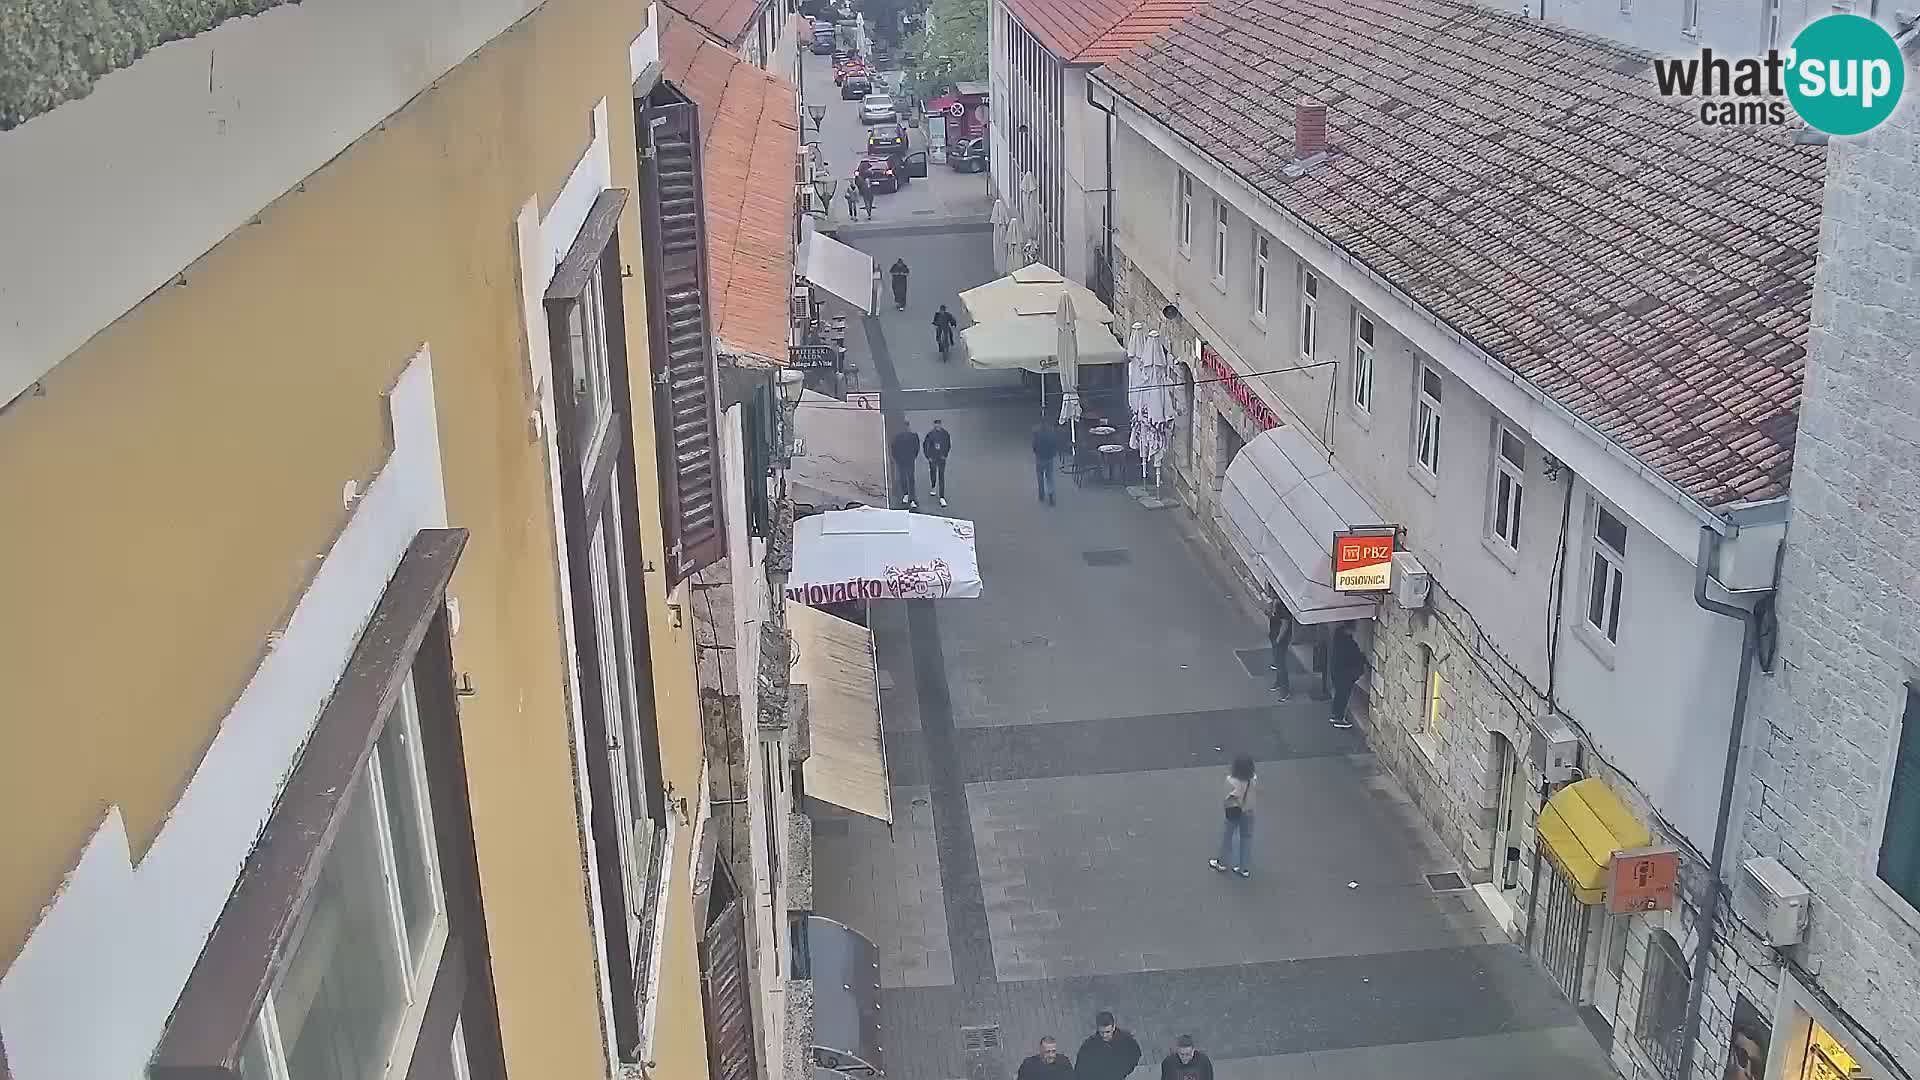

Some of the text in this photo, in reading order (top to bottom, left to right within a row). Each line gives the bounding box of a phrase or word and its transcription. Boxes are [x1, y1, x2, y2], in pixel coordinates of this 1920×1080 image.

[1363, 546, 1388, 559] PBZ
[1340, 574, 1385, 586] POSLOVNICA
[785, 577, 882, 605] arlovačko
